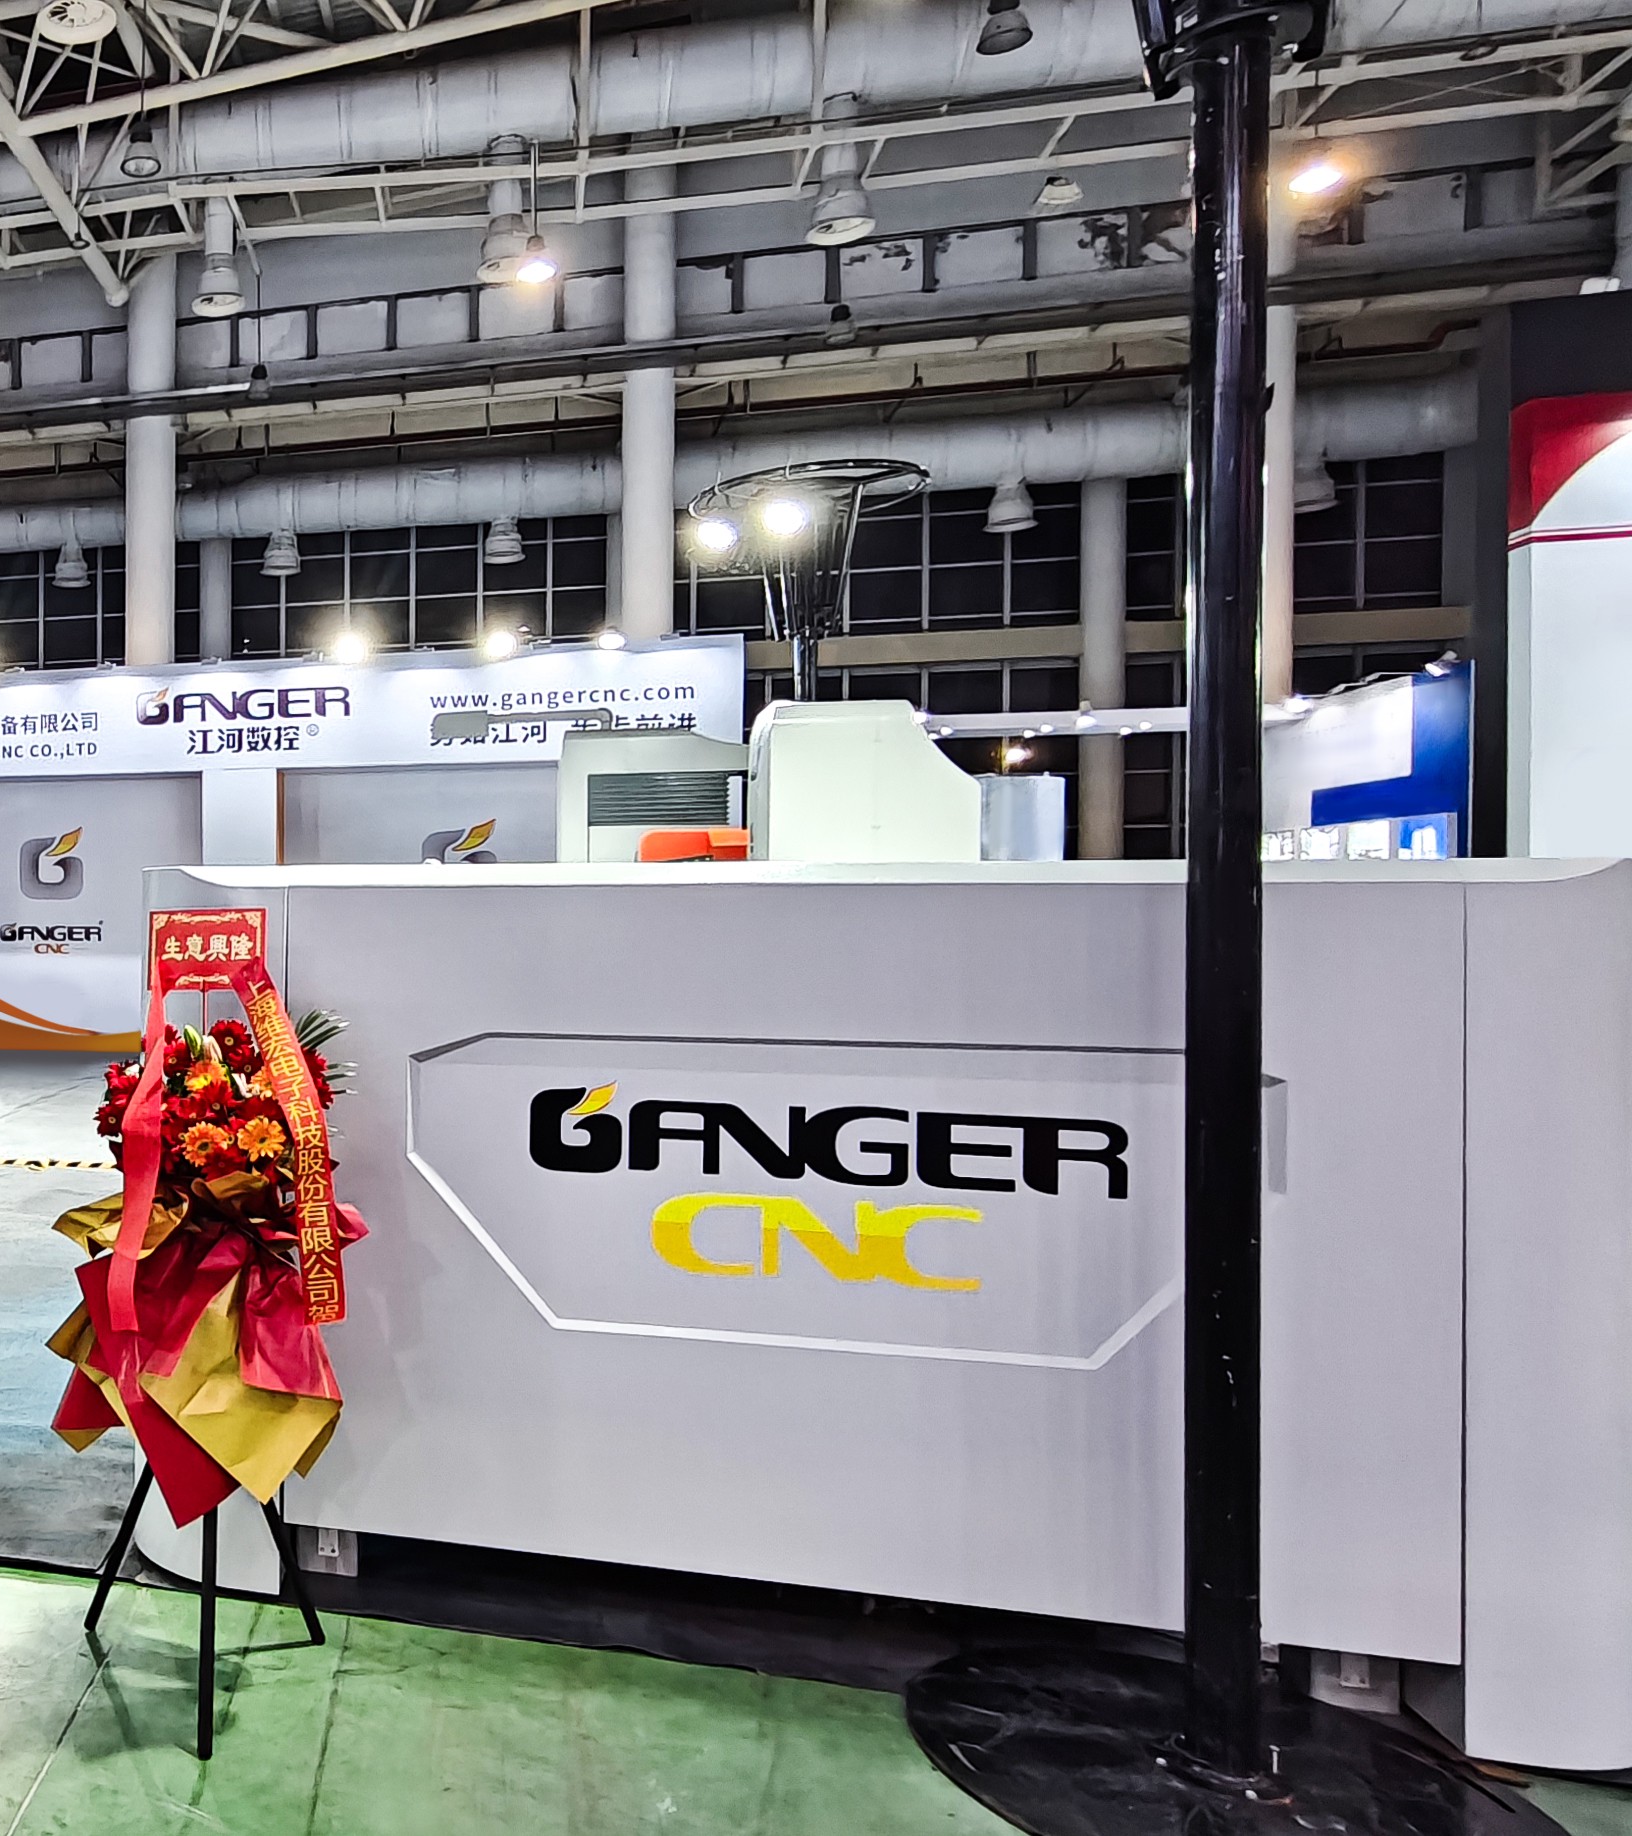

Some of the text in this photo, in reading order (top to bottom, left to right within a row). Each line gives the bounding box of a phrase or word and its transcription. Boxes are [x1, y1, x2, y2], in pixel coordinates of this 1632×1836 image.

[136, 686, 351, 726] GANGER
[429, 685, 695, 710] www.gangercnc.com
[29, 742, 98, 759] CO.,LTD
[186, 726, 300, 755] 江河数控
[0, 922, 102, 942] GANGER
[34, 943, 70, 955] CNC
[161, 932, 254, 962] 生意興隆
[529, 1080, 1129, 1200] GANGER
[650, 1192, 982, 1292] CNC
